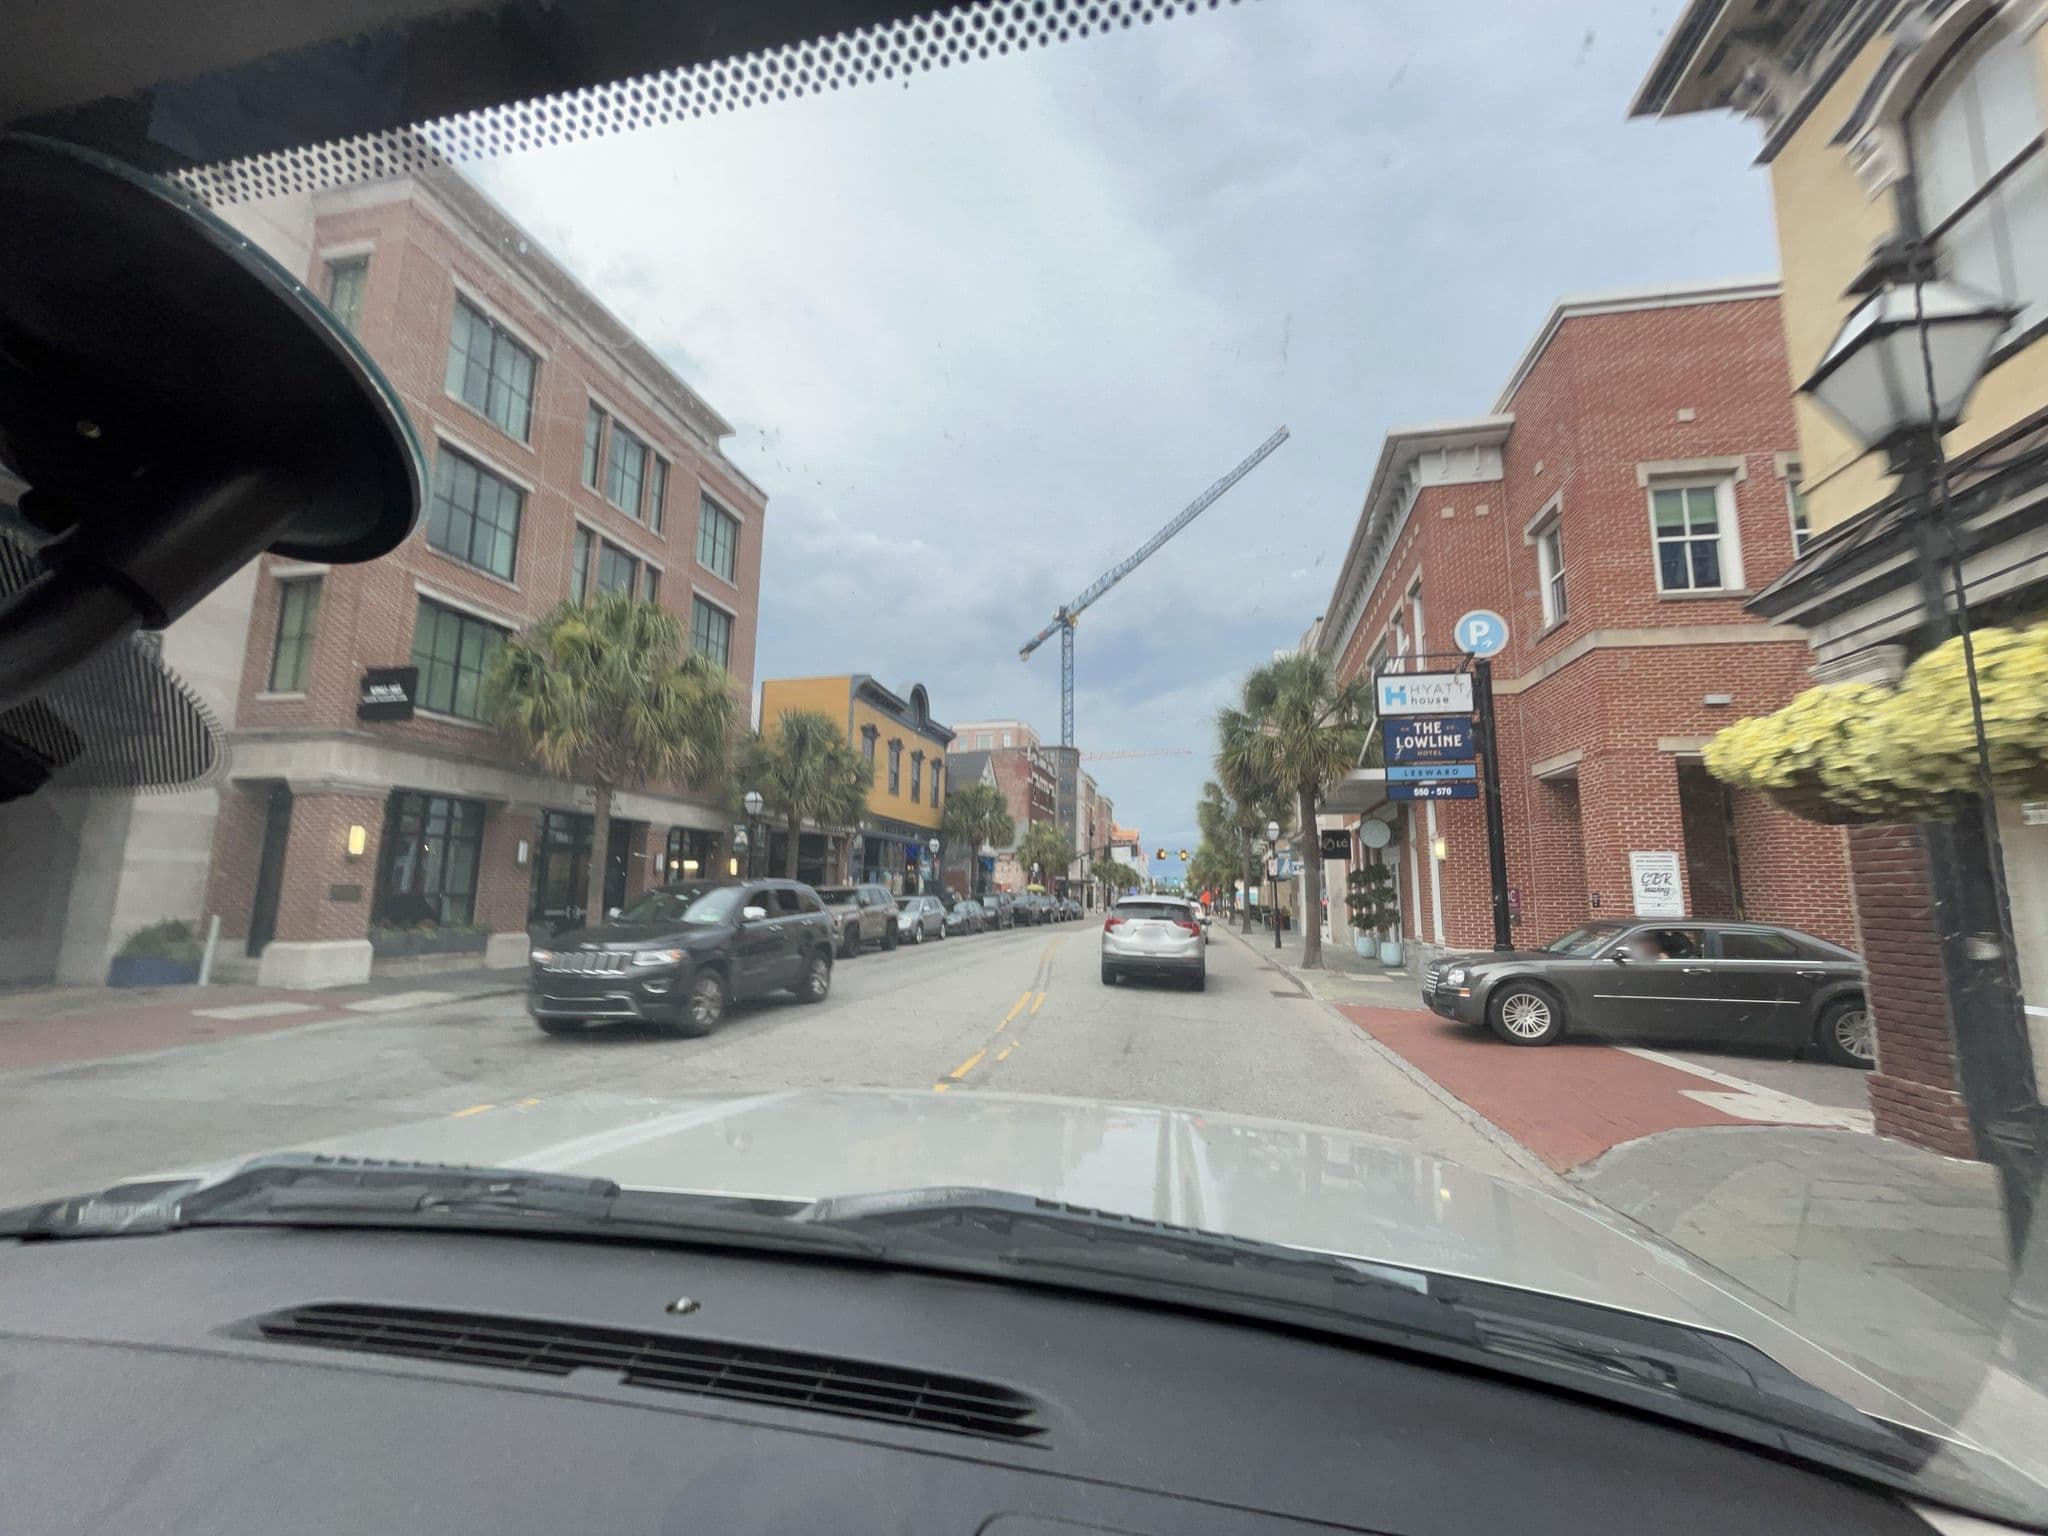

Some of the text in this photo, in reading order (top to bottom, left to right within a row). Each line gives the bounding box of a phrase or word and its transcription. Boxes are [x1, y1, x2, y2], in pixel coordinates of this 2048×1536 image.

[1470, 620, 1489, 646] P
[1410, 682, 1464, 695] HYATT
[1410, 696, 1449, 705] house
[1413, 721, 1442, 735] THE
[1396, 734, 1463, 749] LOWLINE
[1417, 749, 1443, 757] HOTEL
[1404, 768, 1459, 777] LEEWARD
[1641, 872, 1673, 886] CBR
[1641, 883, 1671, 896] Towing
